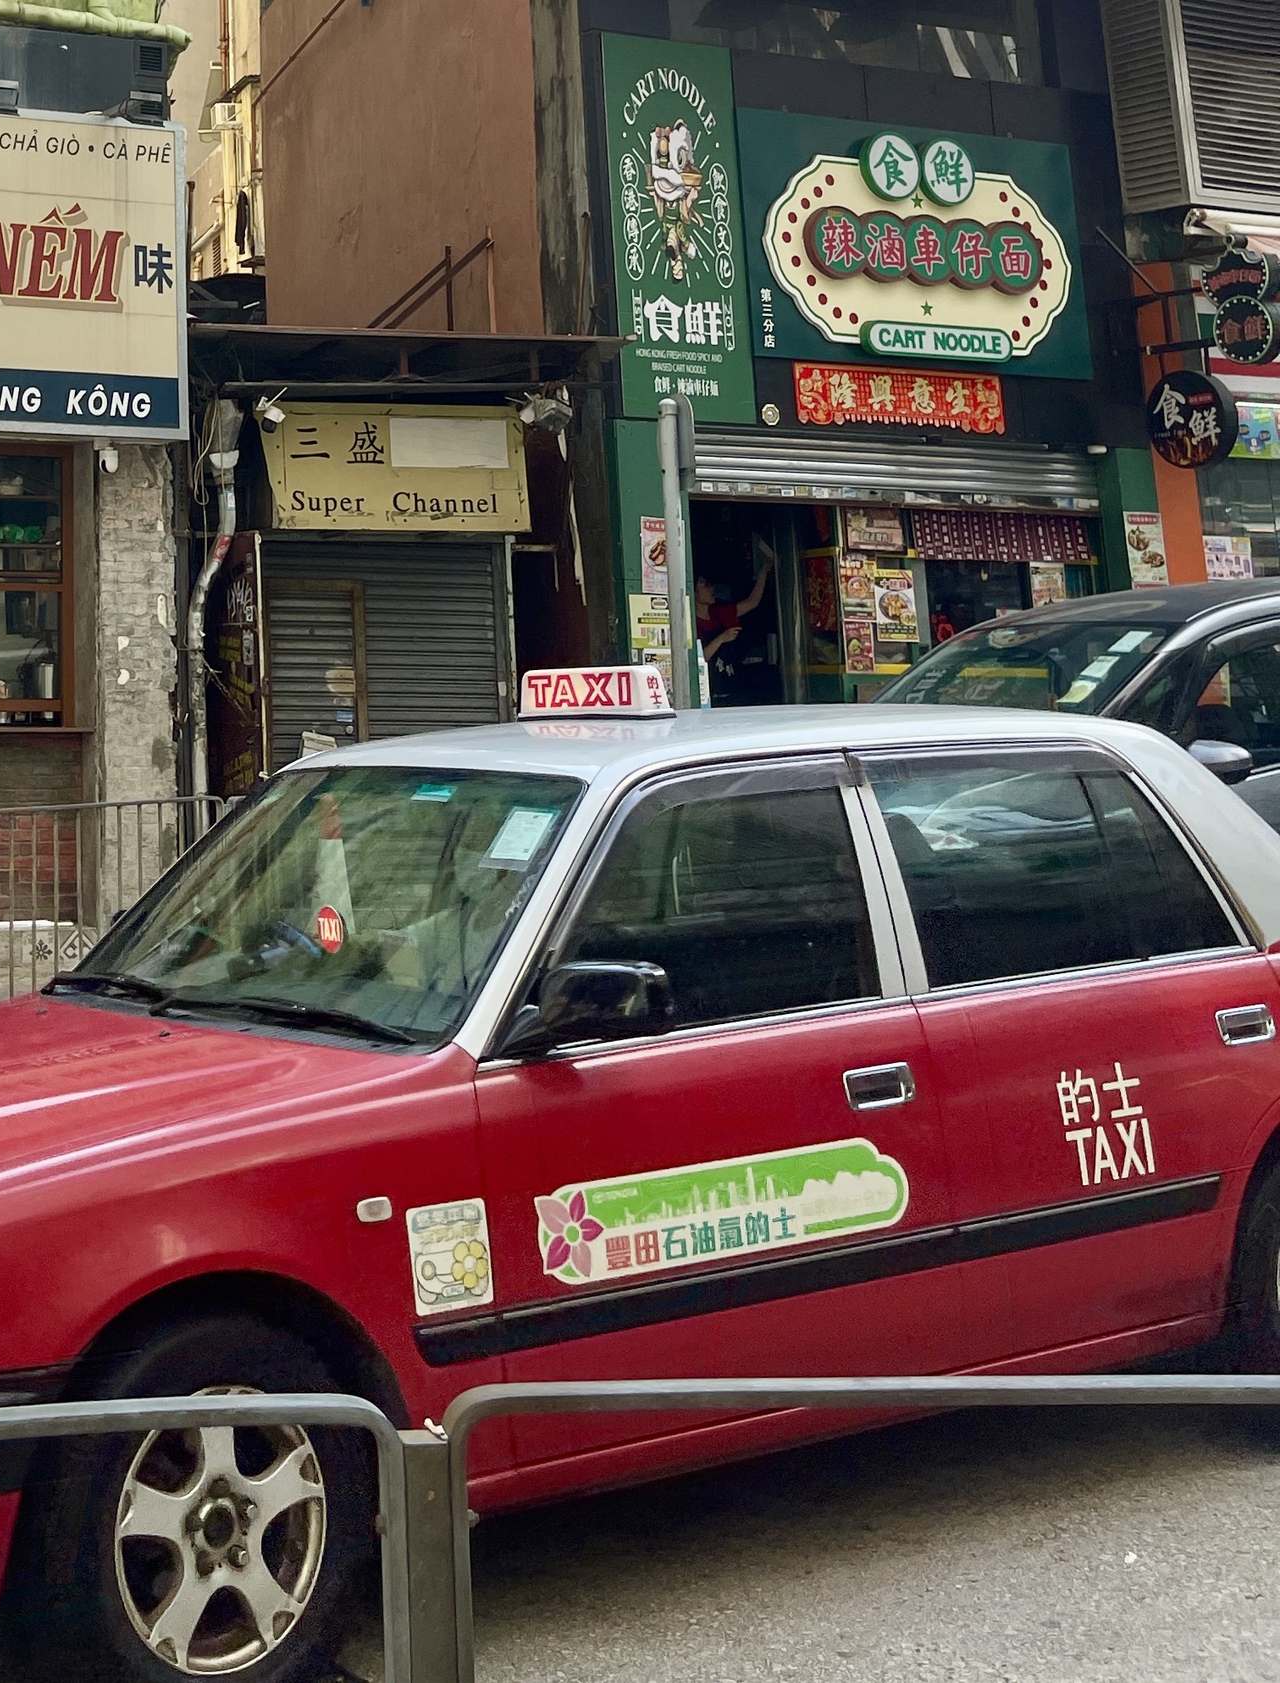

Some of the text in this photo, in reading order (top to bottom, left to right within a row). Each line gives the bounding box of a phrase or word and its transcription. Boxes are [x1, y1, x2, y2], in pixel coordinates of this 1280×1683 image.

[622, 67, 716, 136] CART NOODLE
[46, 130, 81, 157] GIÒ
[103, 134, 129, 161] CÀ
[135, 137, 171, 165] PHÊ
[874, 141, 969, 197] 食鮮
[622, 158, 644, 274] 香港傳承
[712, 167, 733, 284] 飲食文化
[133, 242, 174, 295] 味
[822, 214, 1033, 279] 辣滷車仔面
[643, 294, 724, 345] 食鮮
[760, 288, 776, 349] 第三分店
[878, 327, 1002, 355] CART NOODLE
[636, 348, 652, 358] HONG
[652, 349, 666, 359] KONG
[682, 351, 697, 361] FOOD
[711, 353, 723, 363] AND
[673, 363, 685, 373] CART
[686, 364, 707, 375] NOODLE
[66, 378, 152, 419] KÔNG
[1153, 383, 1222, 447] 食鮮
[289, 421, 385, 465] 三盛
[291, 490, 499, 517] Super Channel
[527, 672, 632, 708] TAXI
[646, 675, 663, 705] 的士
[318, 917, 341, 942] TAXI
[1056, 1062, 1143, 1126] 的士
[1065, 1117, 1155, 1186] TAXI
